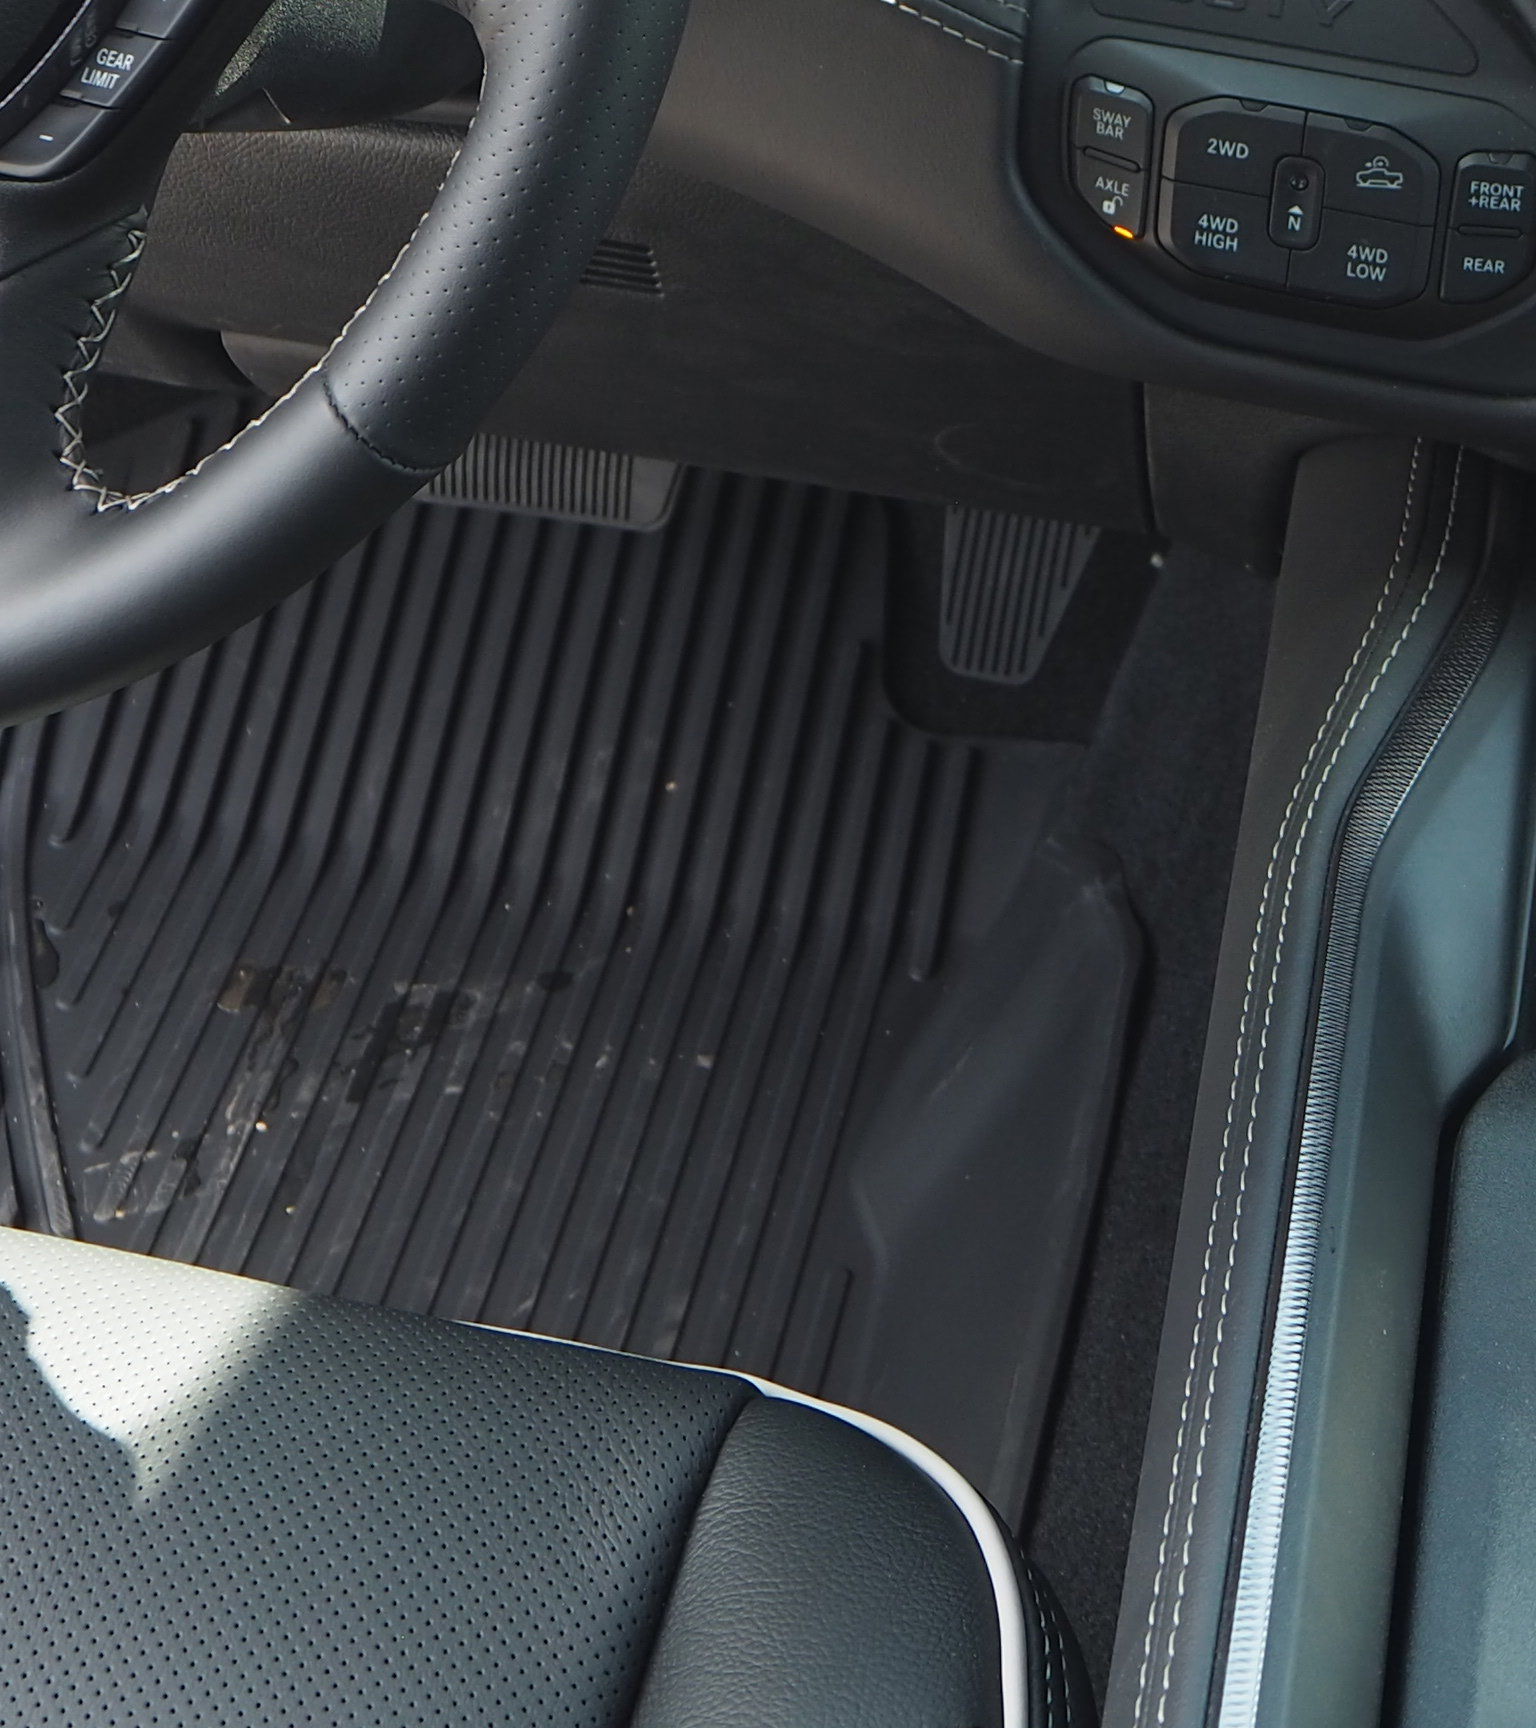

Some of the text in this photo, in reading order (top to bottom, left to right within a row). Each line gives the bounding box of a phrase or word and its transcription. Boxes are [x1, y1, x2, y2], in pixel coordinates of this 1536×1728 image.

[96, 48, 135, 71] GEAR
[81, 67, 121, 89] LIMIT
[1093, 107, 1132, 128] SWAY
[1096, 122, 1124, 141] BAR
[1207, 138, 1250, 159] 2WD
[1095, 176, 1130, 198] AXLE
[1470, 181, 1524, 199] FRONT
[1198, 214, 1239, 234] 4WD
[1288, 215, 1301, 232] N
[1194, 231, 1239, 253] HIGH
[1347, 245, 1388, 265] 4WD
[1346, 262, 1386, 282] LOW
[1464, 257, 1505, 274] REAR
